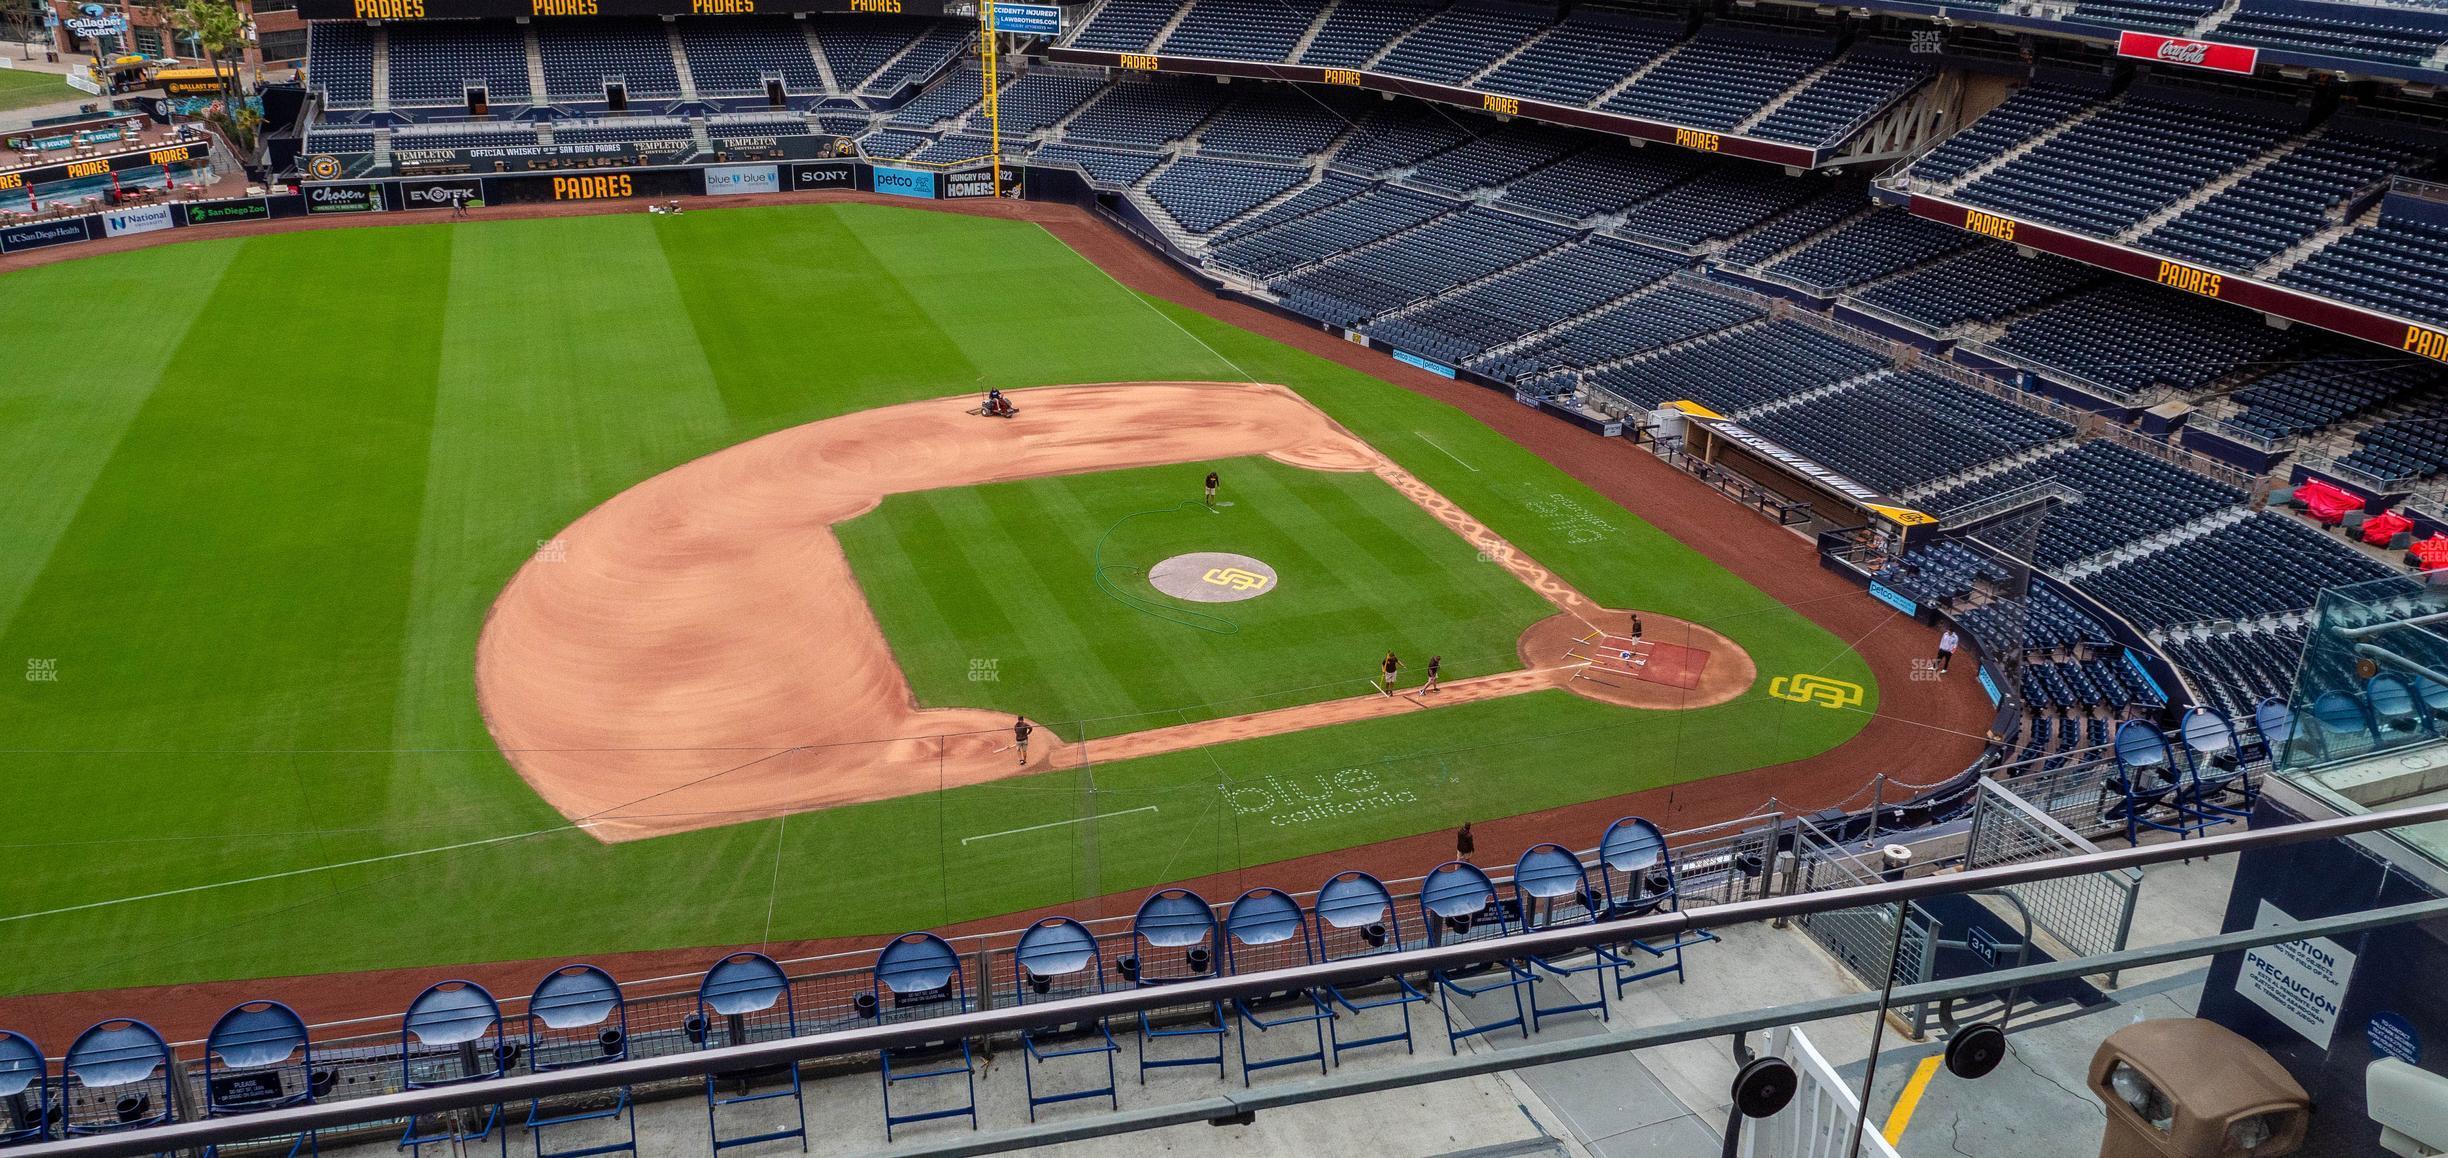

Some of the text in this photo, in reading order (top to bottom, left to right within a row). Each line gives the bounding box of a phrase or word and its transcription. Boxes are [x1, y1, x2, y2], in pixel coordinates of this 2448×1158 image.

[354, 0, 424, 18] PADRES
[533, 0, 598, 15] PADRES
[693, 0, 754, 13] PADRES
[851, 0, 901, 13] PADRES
[994, 7, 1057, 17] CCIDENT? INJURED?
[68, 17, 121, 28] Gallagher
[1000, 16, 1057, 26] LAWBROTHERS.COM
[77, 28, 115, 38] Square
[1120, 54, 1158, 70] PADRES
[1325, 69, 1360, 86] PADRES
[1484, 94, 1518, 115] PADRES
[634, 141, 688, 150] TEMPLETON
[722, 138, 776, 148] TEMPLETON
[1676, 128, 1719, 152] PADRES
[150, 148, 189, 164] PADRES
[395, 150, 456, 160] TEMPLETON
[470, 148, 506, 158] OFFICIAL
[506, 146, 541, 155] WHISKEY
[560, 146, 574, 154] SAN
[576, 145, 594, 153] DIEGO
[596, 144, 621, 152] PADRES
[68, 160, 110, 178] PADRES
[802, 170, 848, 182] SONY
[1000, 170, 1012, 180] 322
[708, 174, 730, 184] blue
[743, 173, 765, 182] blue
[877, 174, 912, 187] petco
[950, 173, 977, 182] HUNGRY
[312, 187, 366, 202] Chosen
[553, 174, 632, 200] PADRES
[948, 182, 994, 197] HOMERS
[128, 211, 167, 224] National
[225, 207, 248, 217] Diego
[248, 206, 265, 214] Zoo
[1966, 209, 2016, 240] PADRES
[22, 232, 36, 242] San
[36, 229, 56, 241] Diego
[56, 226, 80, 238] Health
[2158, 260, 2222, 298] PADRES
[1871, 584, 1892, 599] petco
[1219, 768, 1380, 814] blue
[1270, 790, 1417, 826] california
[1972, 938, 1992, 959] 314
[2284, 950, 2340, 986] THE FIELD OF PLAY
[2298, 951, 2306, 959] OF
[2306, 956, 2334, 976] OBJECTS
[2247, 952, 2337, 1016] PRECAUCIÓN
[2250, 973, 2275, 992] OBJETOS
[2275, 989, 2287, 999] QUE
[2258, 971, 2272, 983] ESTE
[2311, 1005, 2320, 1014] DE
[2295, 1010, 2316, 1025] JUEGO
